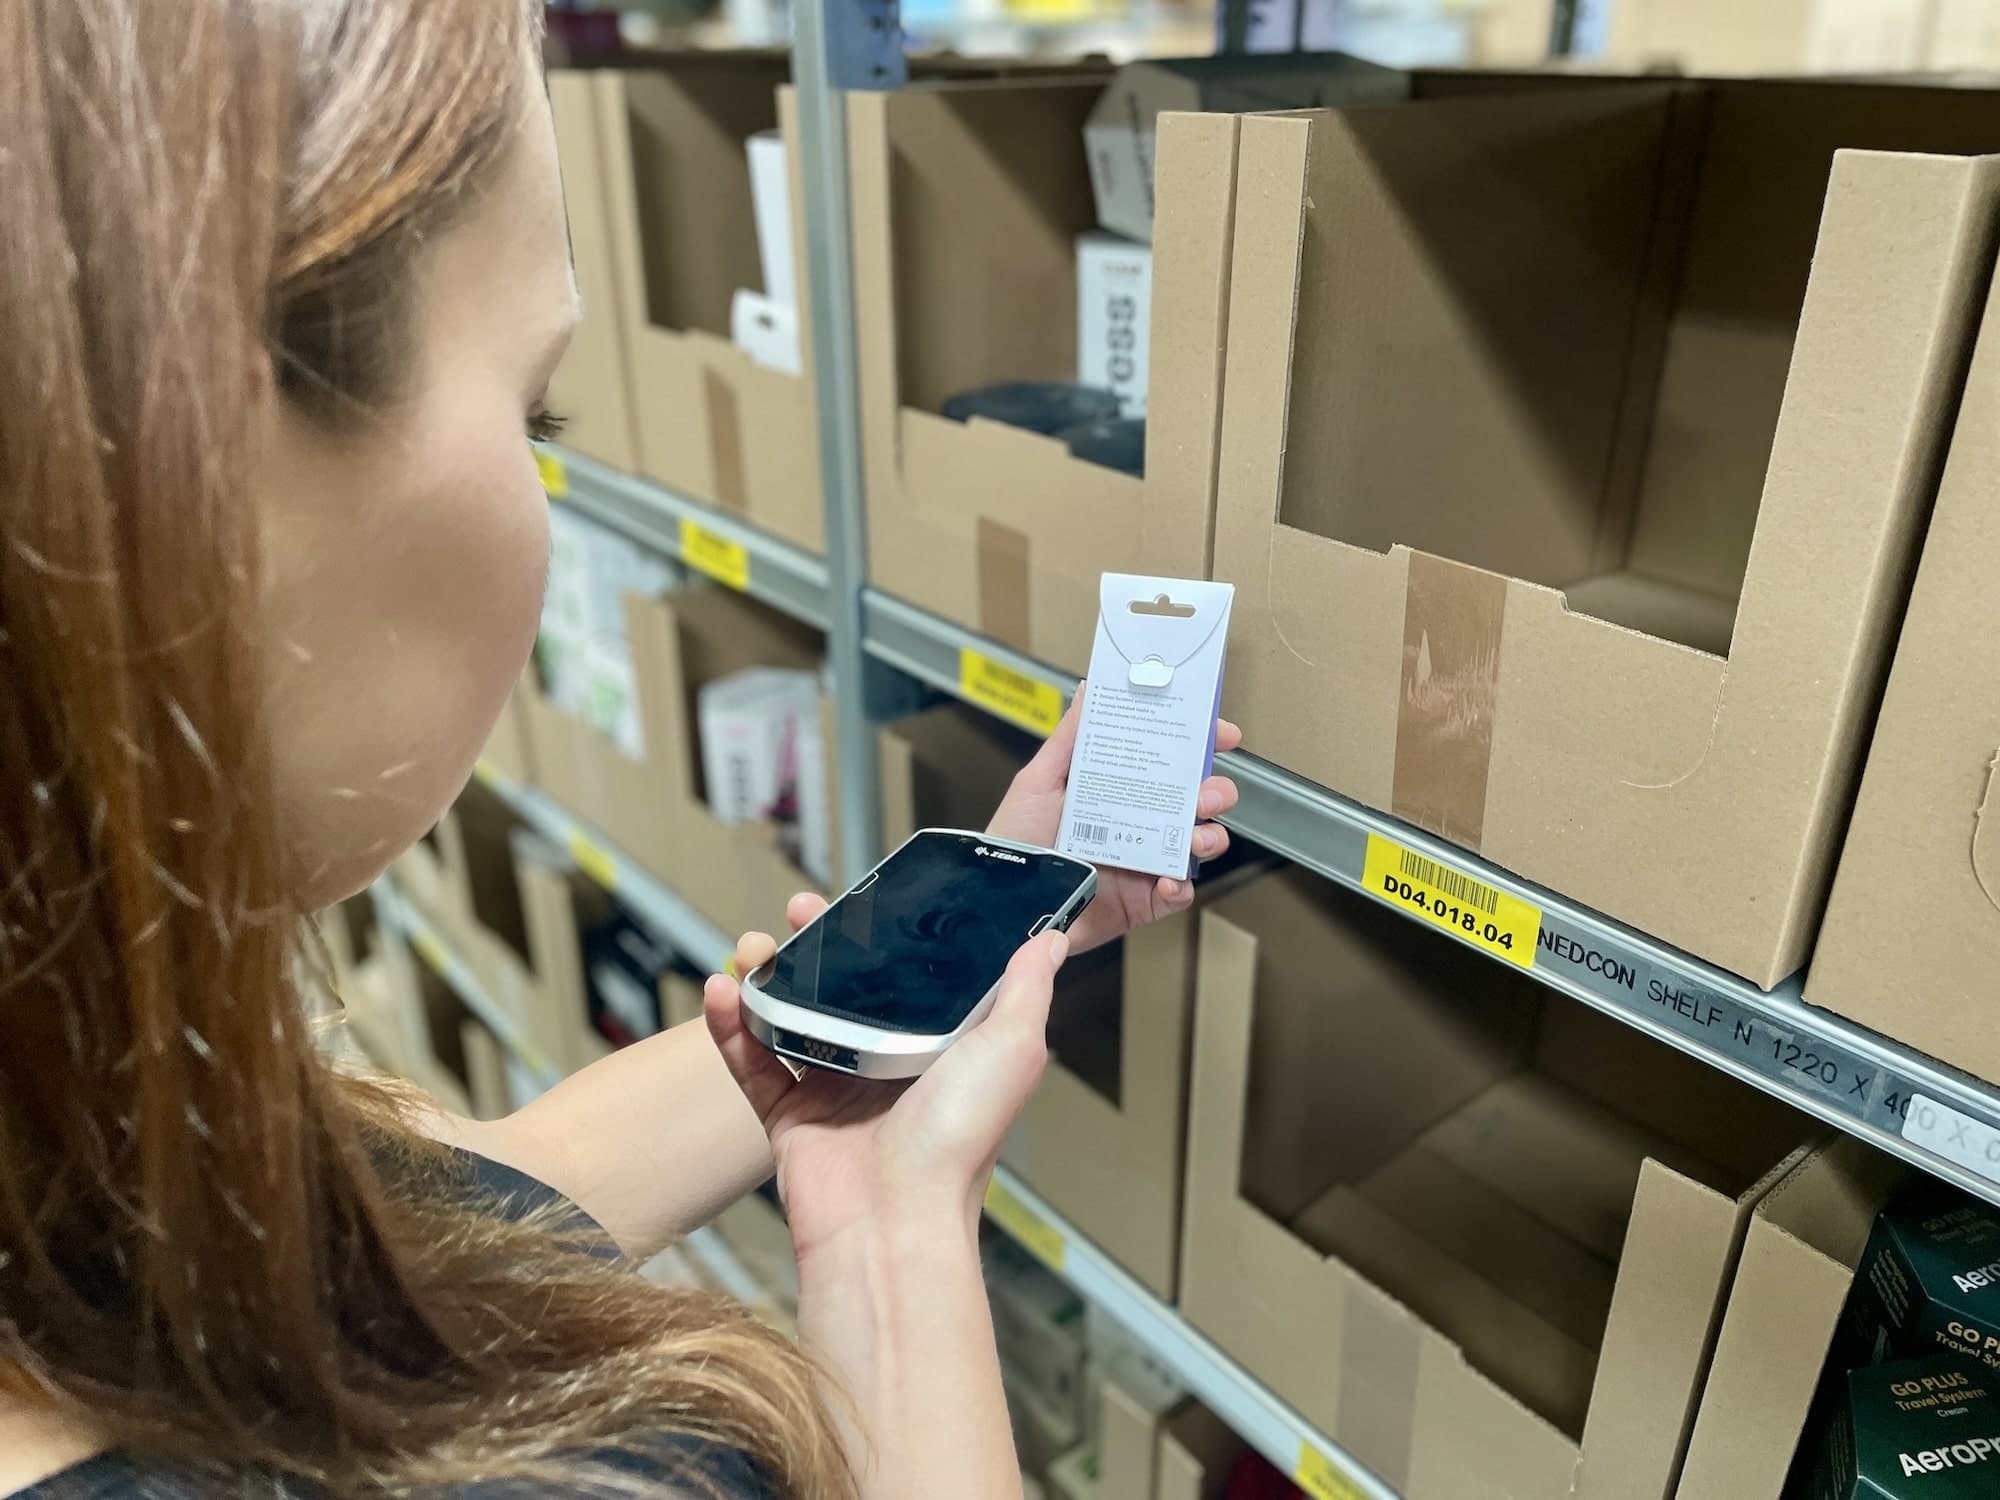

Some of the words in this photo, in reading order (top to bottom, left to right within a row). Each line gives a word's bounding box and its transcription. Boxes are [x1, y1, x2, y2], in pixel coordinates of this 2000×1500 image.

[989, 850, 1026, 865] ZEBRA
[1383, 874, 1514, 951] D04.018.04
[1537, 926, 1636, 990] NEDCON
[1647, 979, 1723, 1028] SHELF
[1734, 1020, 1753, 1046] N
[1772, 1039, 1838, 1085] 1220
[1849, 1074, 1870, 1101] X
[1951, 1258, 2000, 1293] Aero
[1936, 1331, 1981, 1358] Travel
[1947, 1321, 1980, 1343] GO
[1890, 1381, 1922, 1397] GO
[1921, 1372, 1969, 1391] PLUS
[1895, 1394, 1940, 1411] Travel
[1937, 1389, 1987, 1405] System
